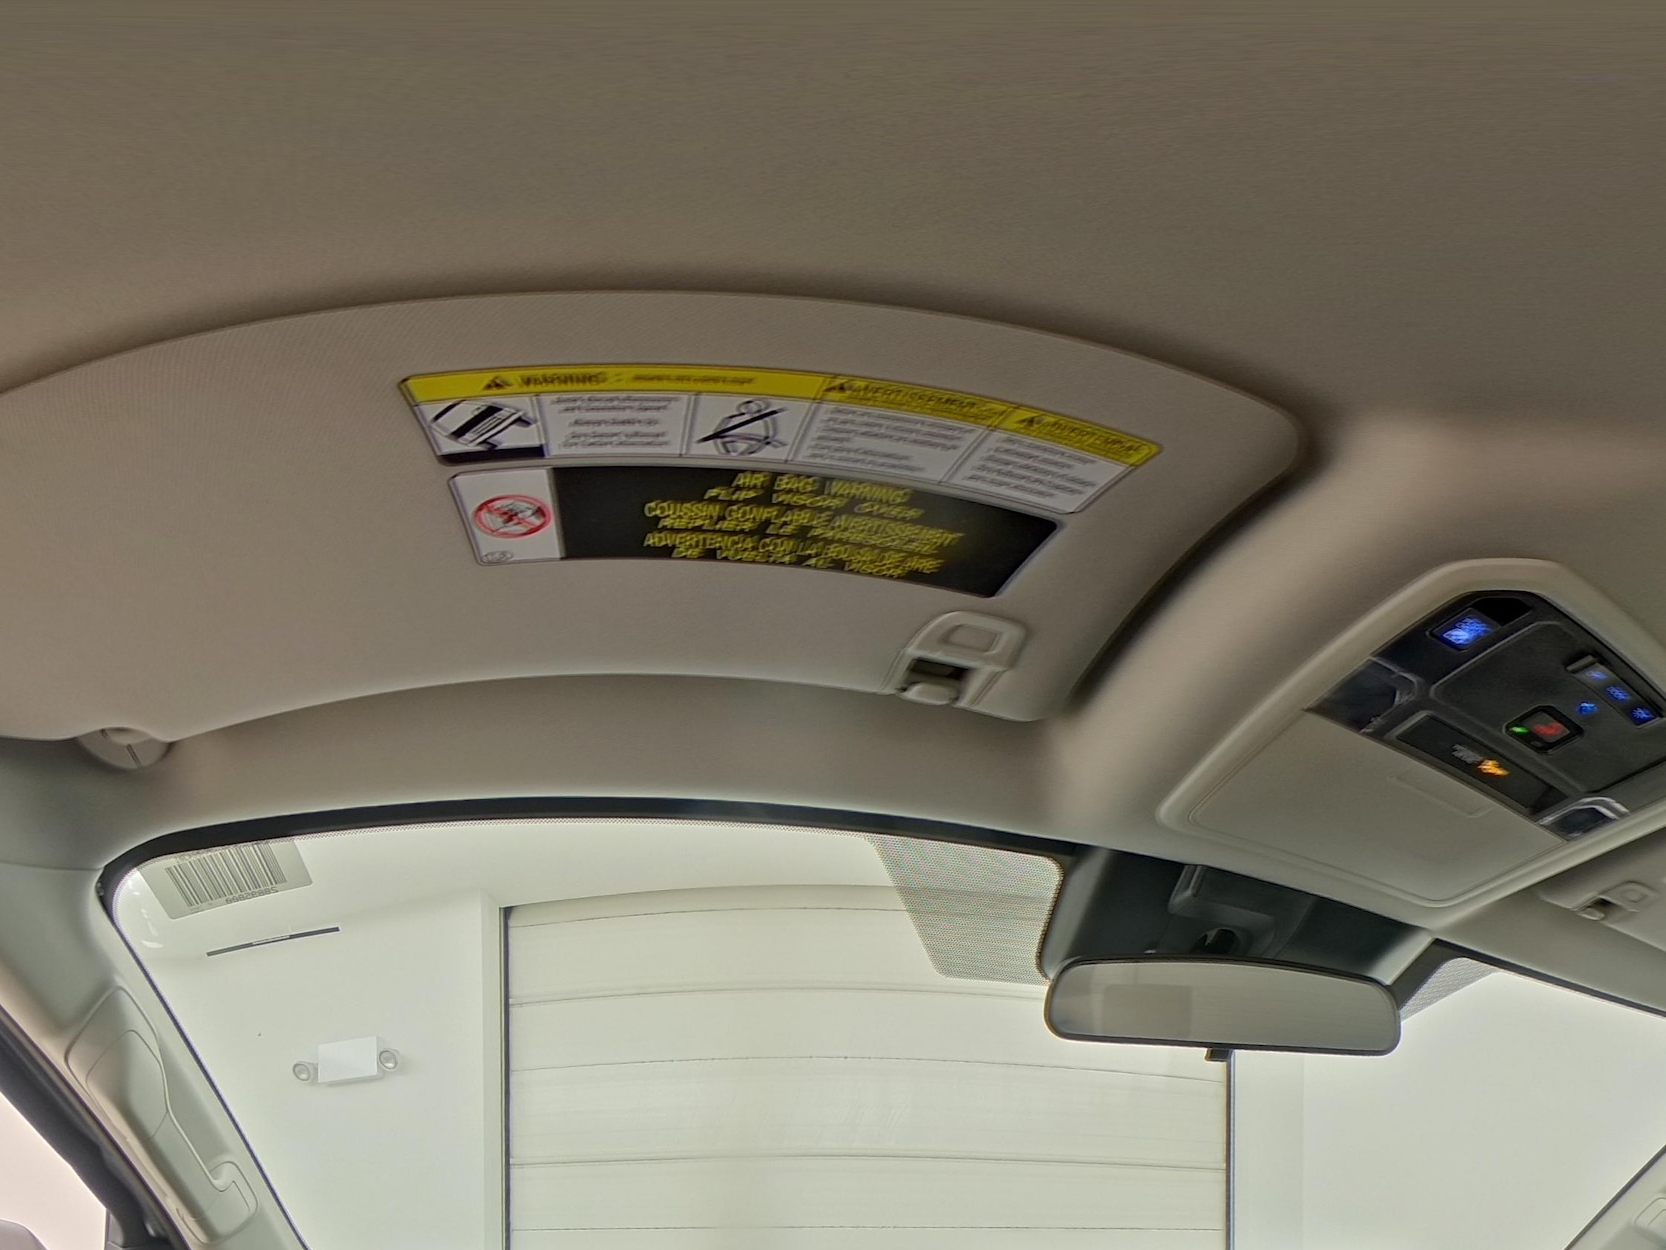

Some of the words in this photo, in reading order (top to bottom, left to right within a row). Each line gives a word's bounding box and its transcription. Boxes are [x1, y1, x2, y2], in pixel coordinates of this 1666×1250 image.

[703, 486, 765, 501] FLIP
[731, 471, 772, 488] AIR
[773, 473, 822, 494] BAG
[824, 479, 914, 505] WARNING
[644, 500, 724, 518] COUSSIN
[643, 531, 759, 550] ADVERTENCIA
